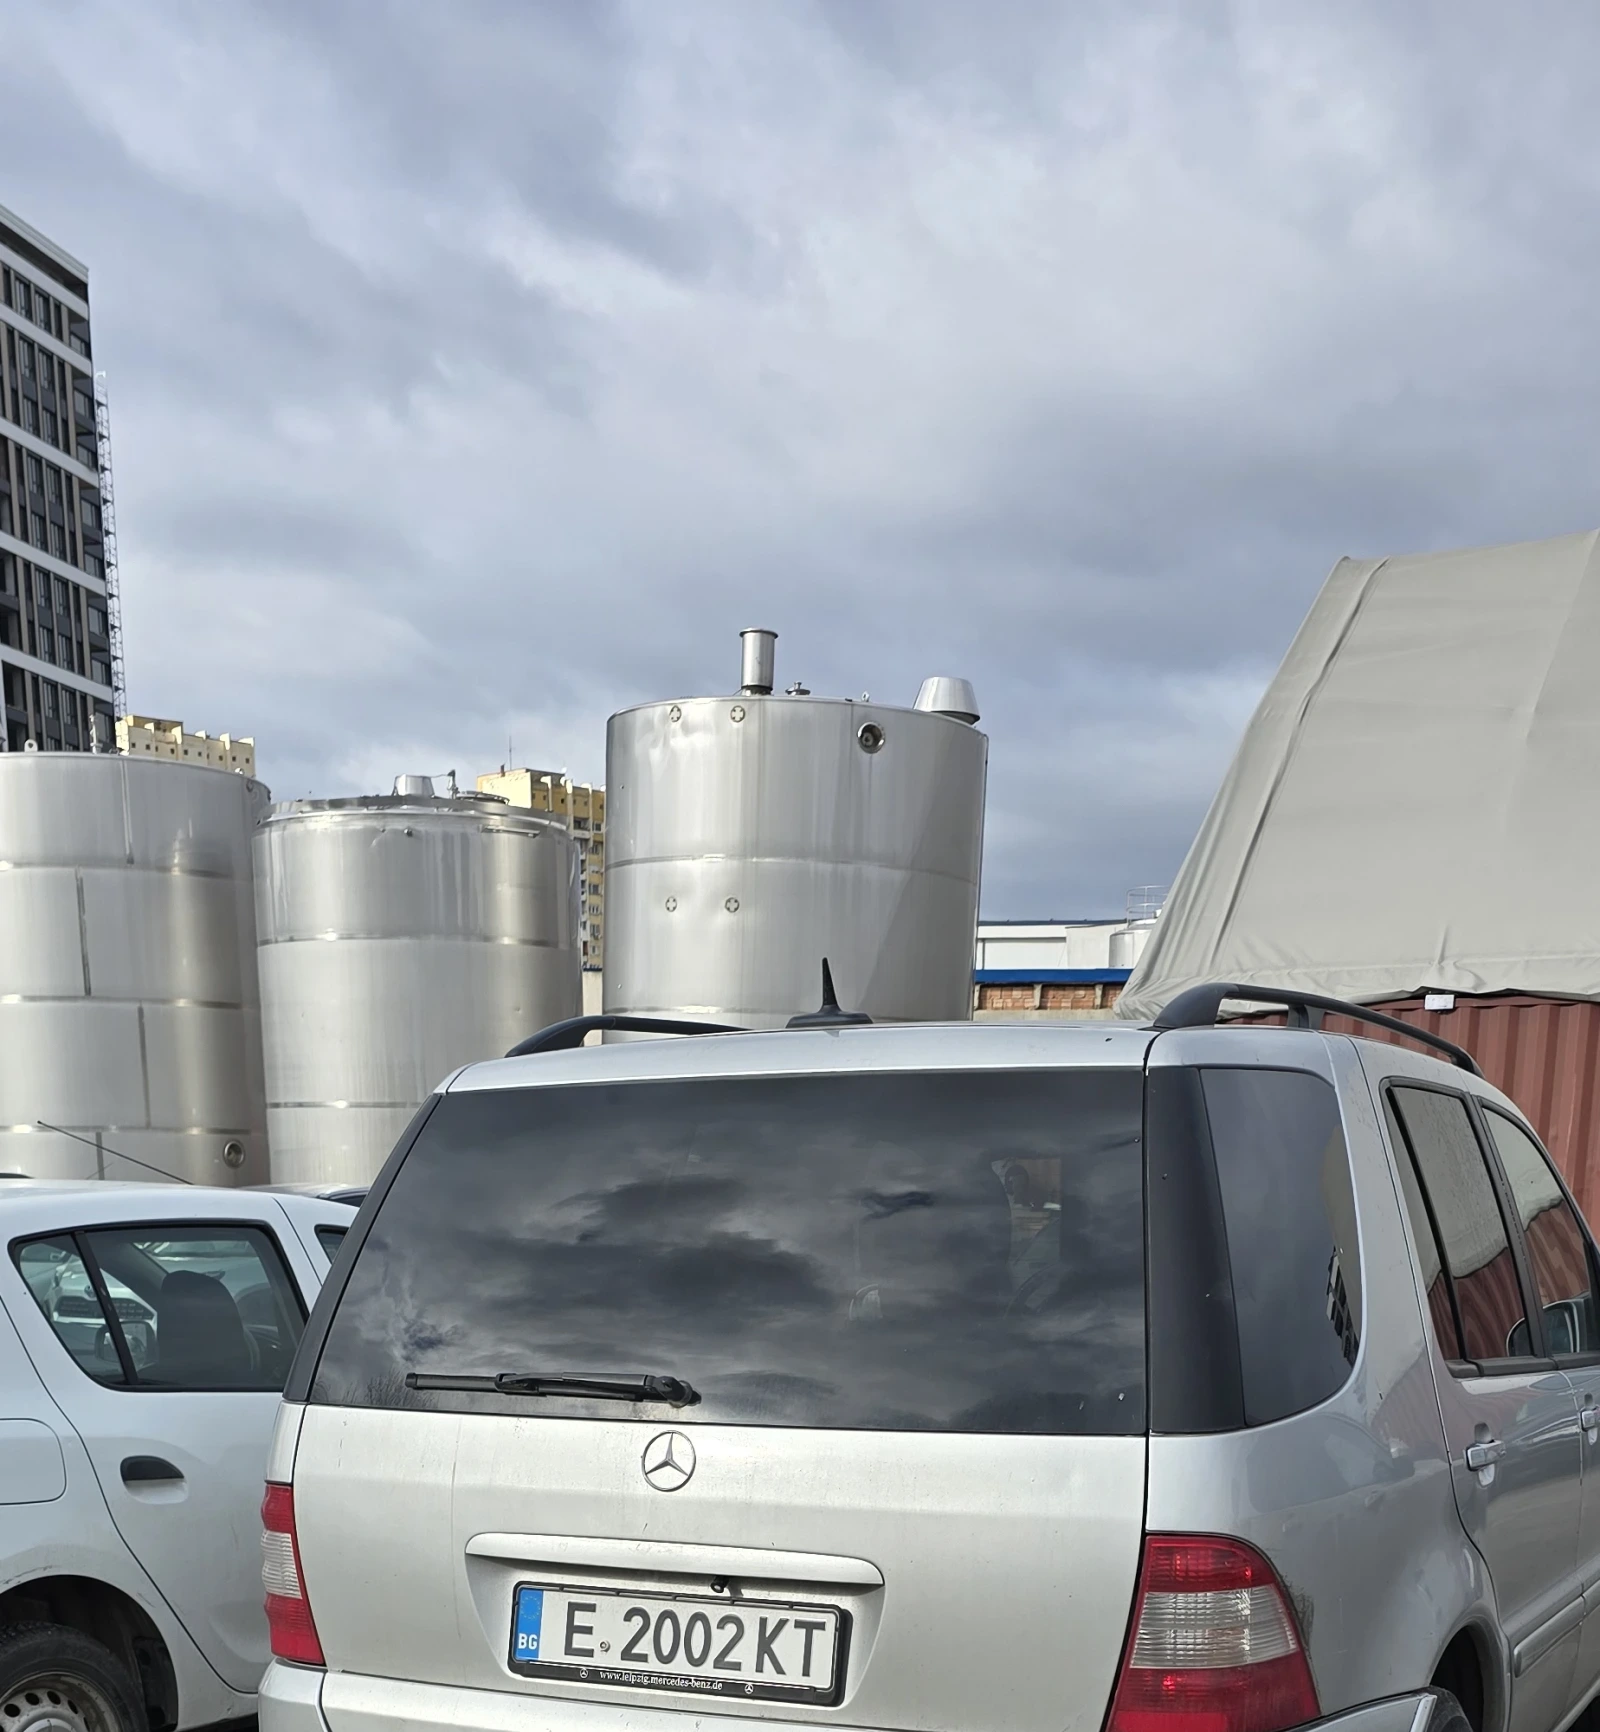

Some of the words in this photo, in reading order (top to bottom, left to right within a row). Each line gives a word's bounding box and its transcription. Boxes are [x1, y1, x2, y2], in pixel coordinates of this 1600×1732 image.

[564, 1601, 597, 1658] E
[518, 1633, 538, 1650] BG
[599, 1671, 723, 1690] www.leipzig.mercedes-benz.de
